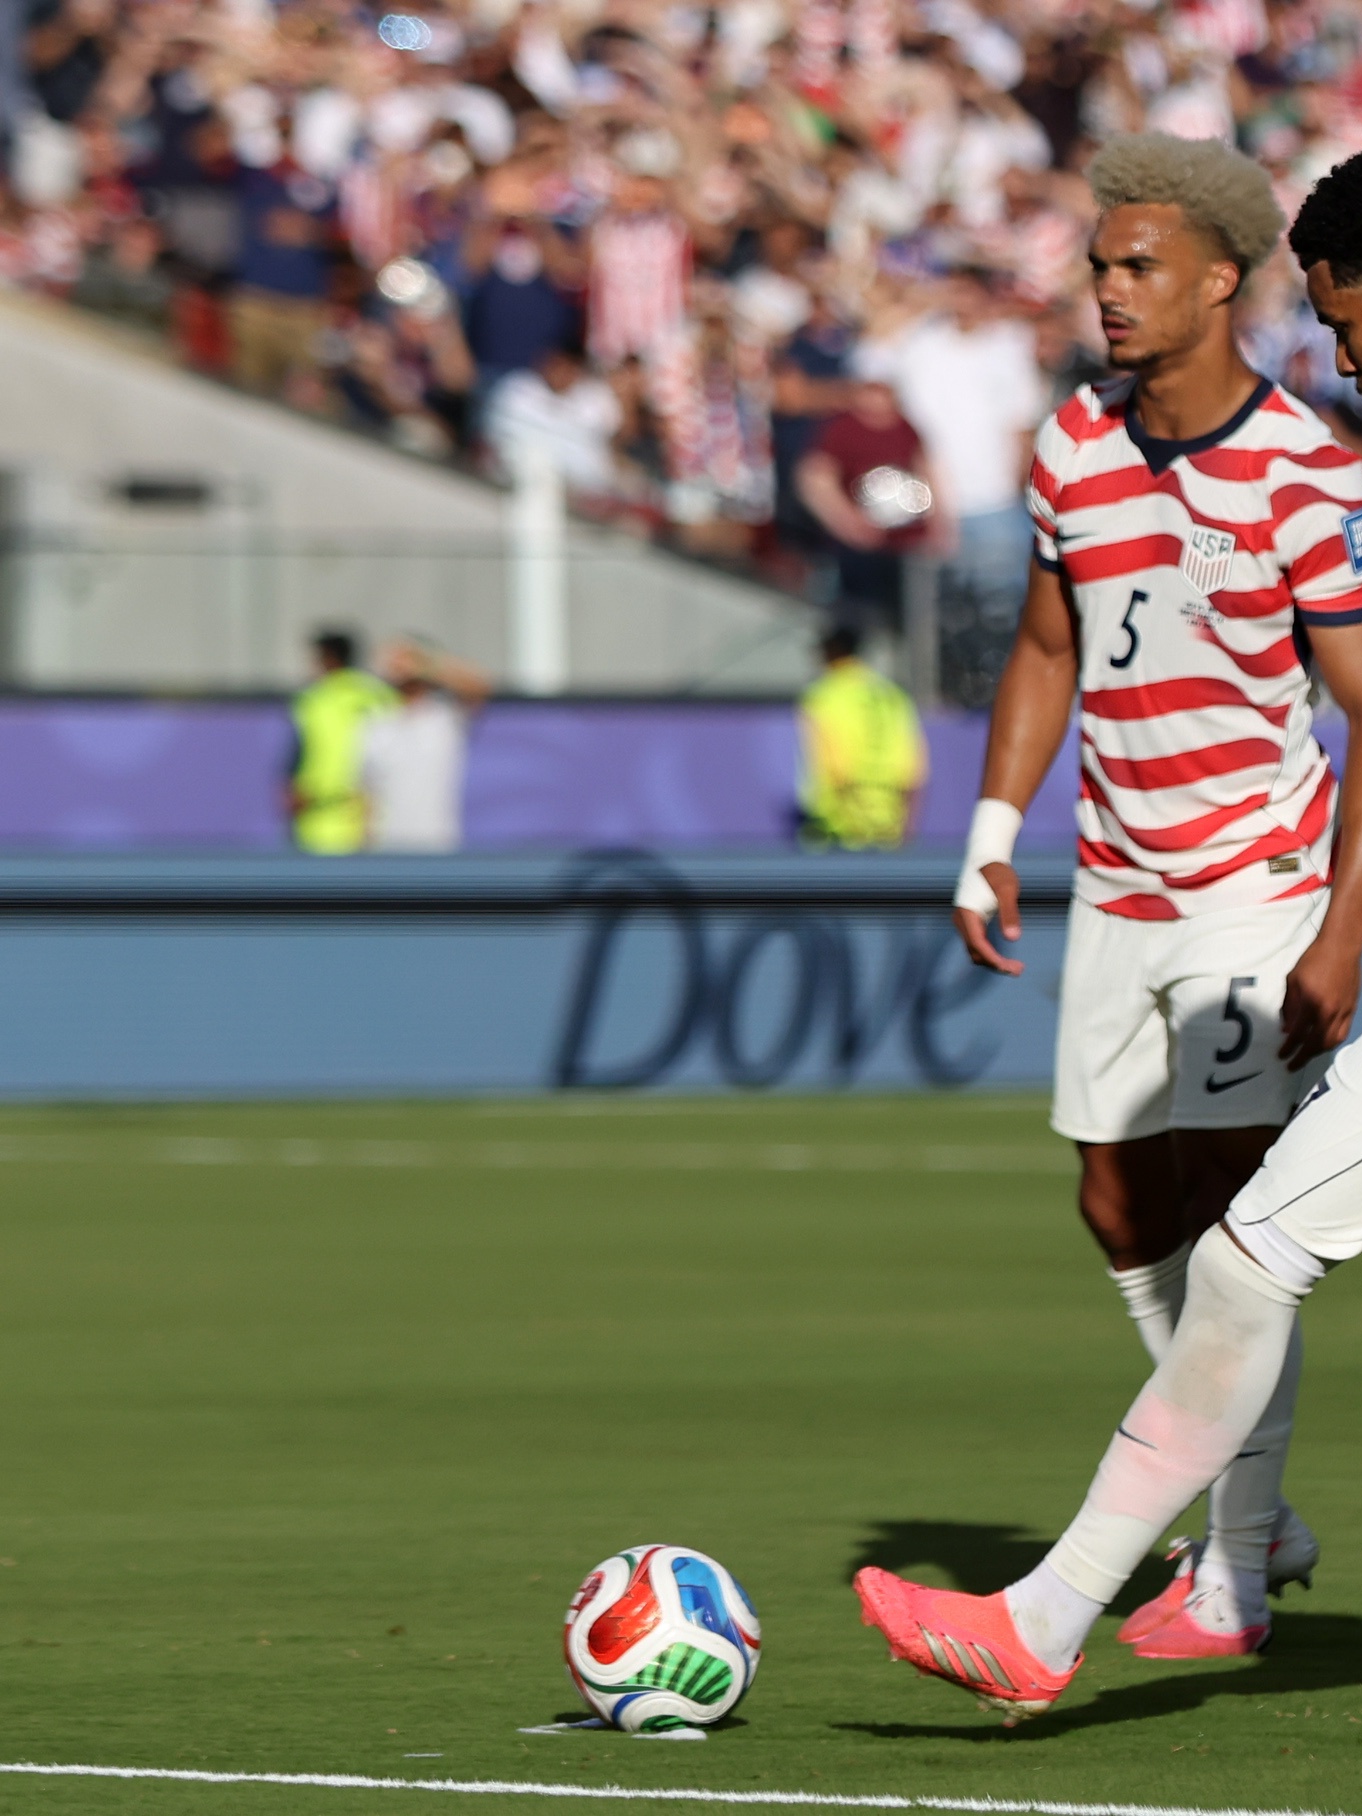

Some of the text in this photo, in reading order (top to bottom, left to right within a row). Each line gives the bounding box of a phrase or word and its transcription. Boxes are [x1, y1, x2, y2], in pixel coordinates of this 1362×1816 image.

[1191, 529, 1232, 559] USA
[1109, 589, 1150, 669] 5
[1214, 977, 1256, 1063] 5
